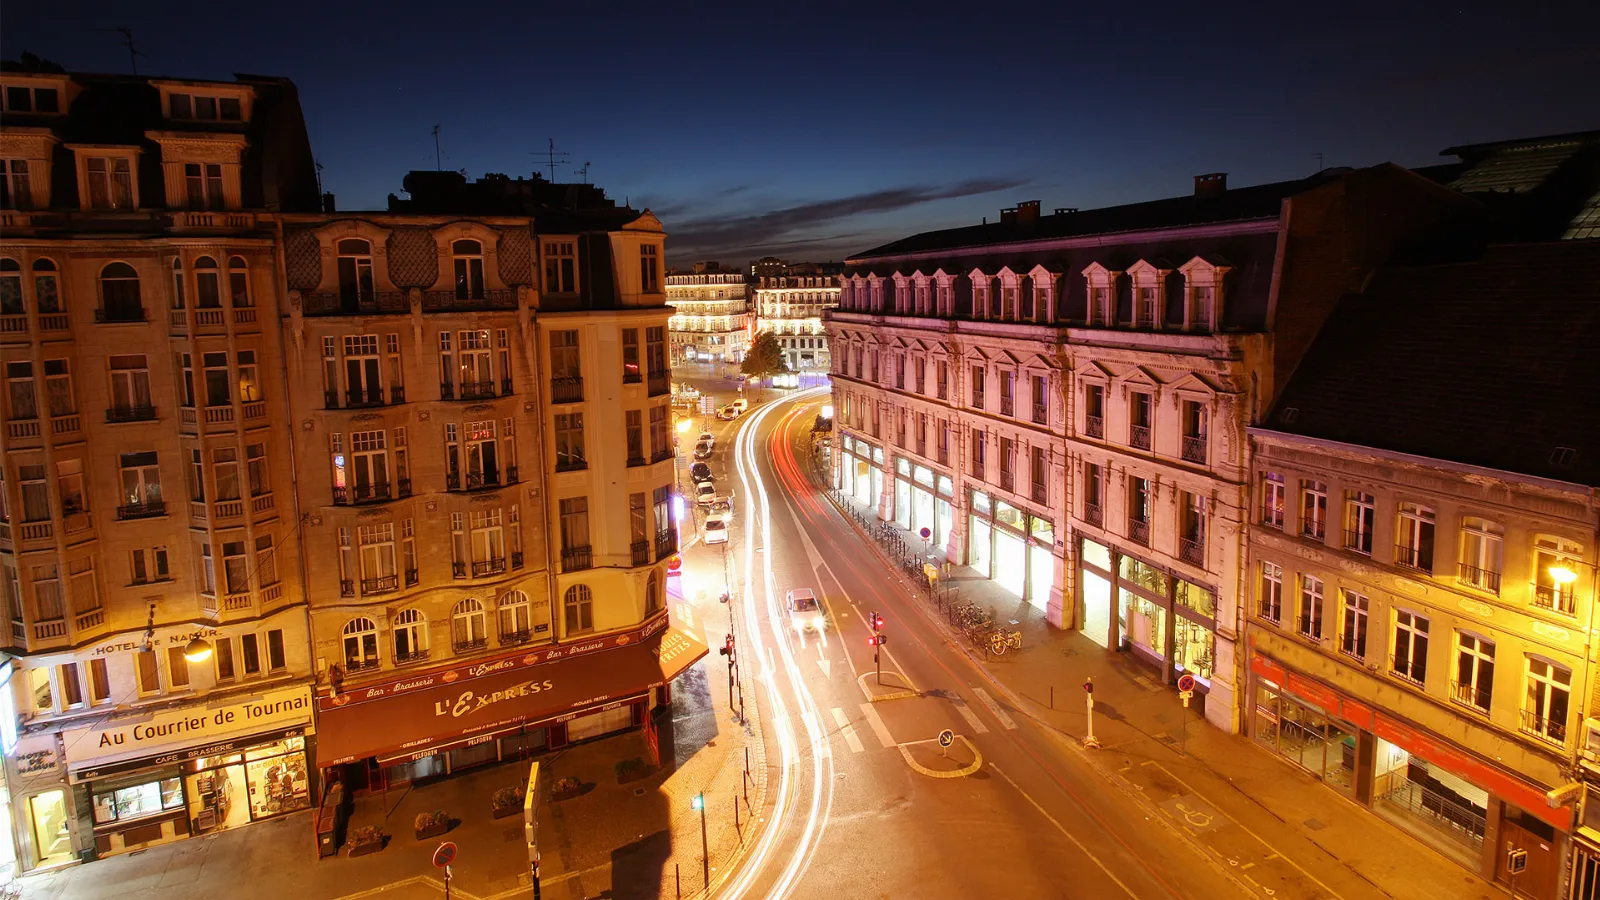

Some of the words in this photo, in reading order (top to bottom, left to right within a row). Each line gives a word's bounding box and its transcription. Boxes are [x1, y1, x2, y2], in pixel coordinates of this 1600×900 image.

[96, 641, 139, 655] HOTEL
[660, 641, 690, 663] FRITES
[366, 688, 384, 698] Bar
[393, 676, 434, 692] Brasserie
[99, 732, 124, 748] Au
[133, 717, 207, 740] Courrier
[214, 710, 234, 725] de
[243, 694, 308, 719] Tournai
[188, 743, 233, 758] BRASSERIE
